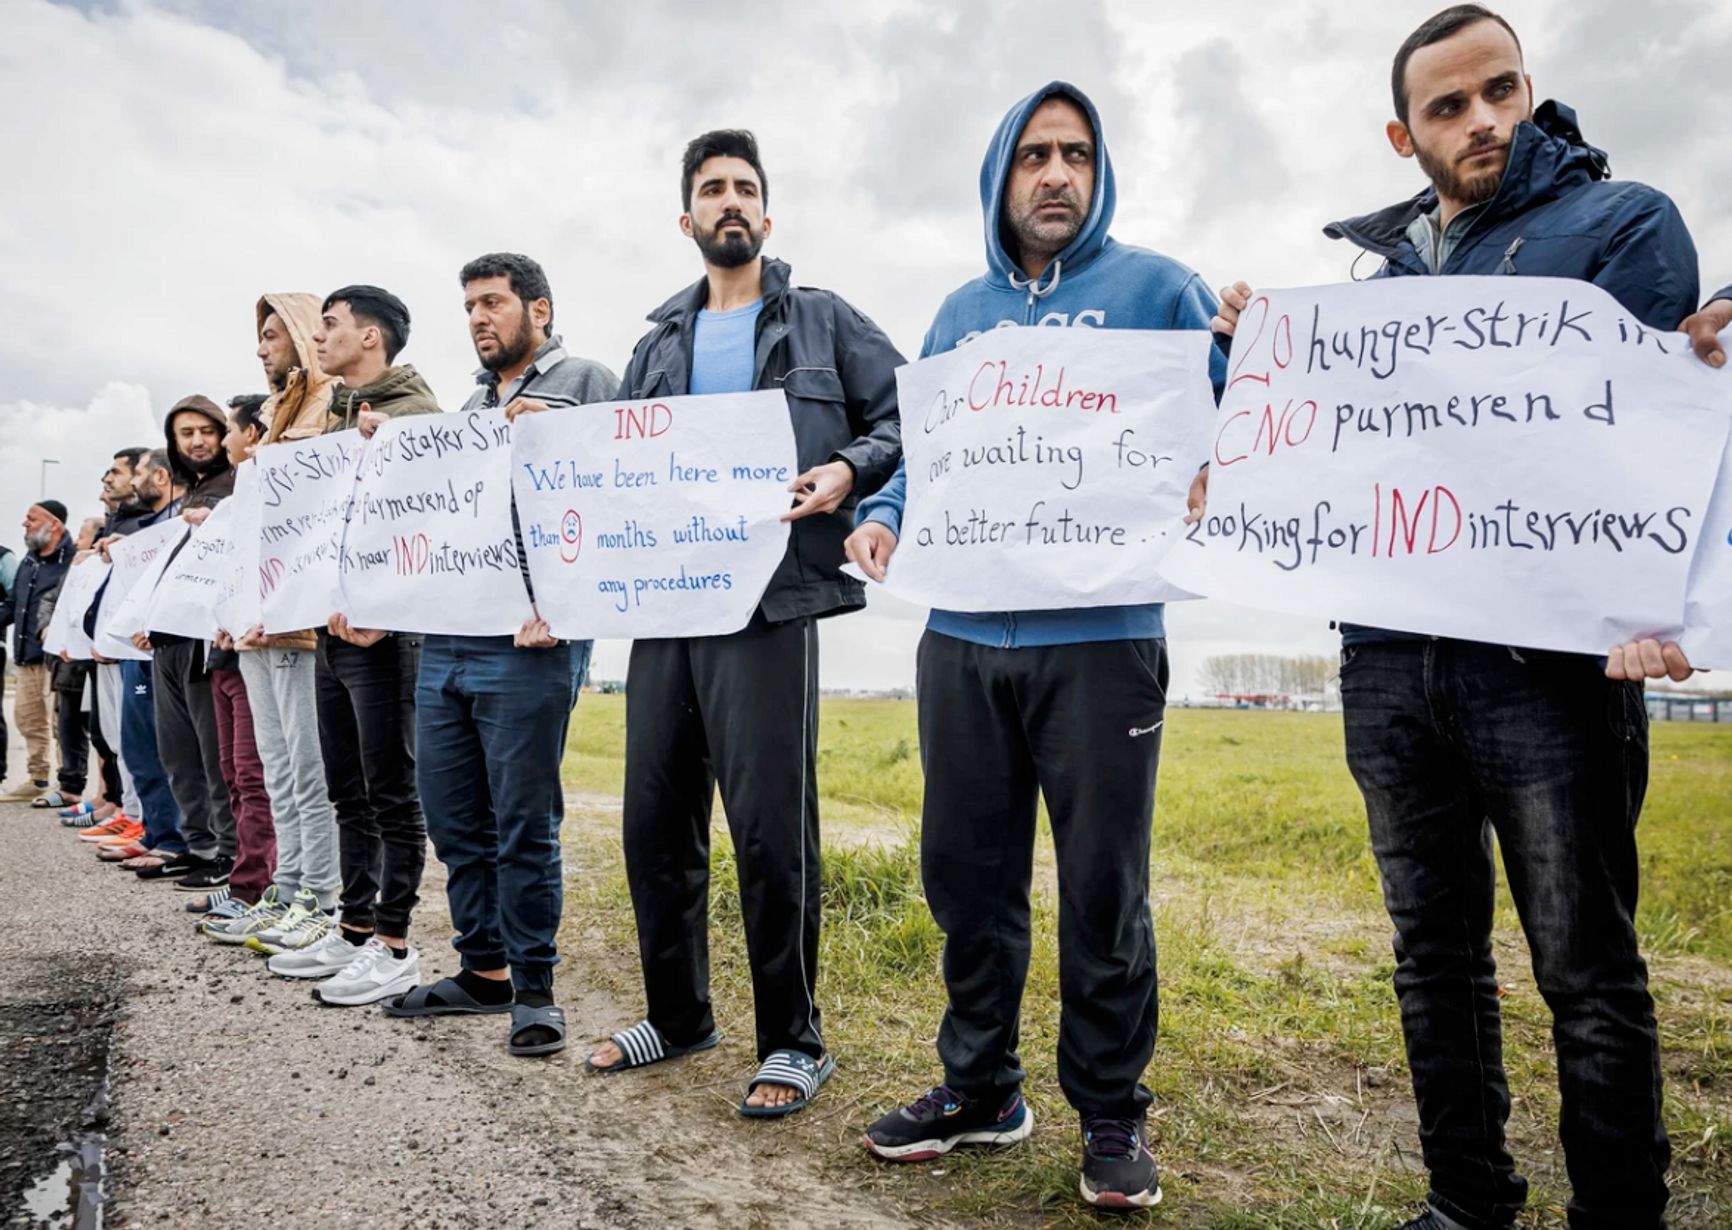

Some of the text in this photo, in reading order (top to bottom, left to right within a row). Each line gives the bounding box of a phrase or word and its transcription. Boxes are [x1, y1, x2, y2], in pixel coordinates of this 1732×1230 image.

[1228, 297, 1292, 389] 20
[968, 360, 1121, 413] Children
[614, 403, 673, 439] IND
[1216, 400, 1317, 466] CNO
[524, 452, 790, 491] We have been here more
[963, 426, 1083, 490] waiting
[1112, 429, 1172, 468] for
[464, 481, 484, 518] op
[530, 525, 561, 548] than
[597, 521, 658, 549] months
[673, 515, 749, 544] without
[917, 527, 934, 547] a
[945, 510, 1015, 546] better
[1306, 501, 1368, 565] for
[1371, 483, 1462, 558] IND
[393, 532, 430, 576] IND
[258, 557, 286, 600] ND
[598, 564, 733, 612] any procedures
